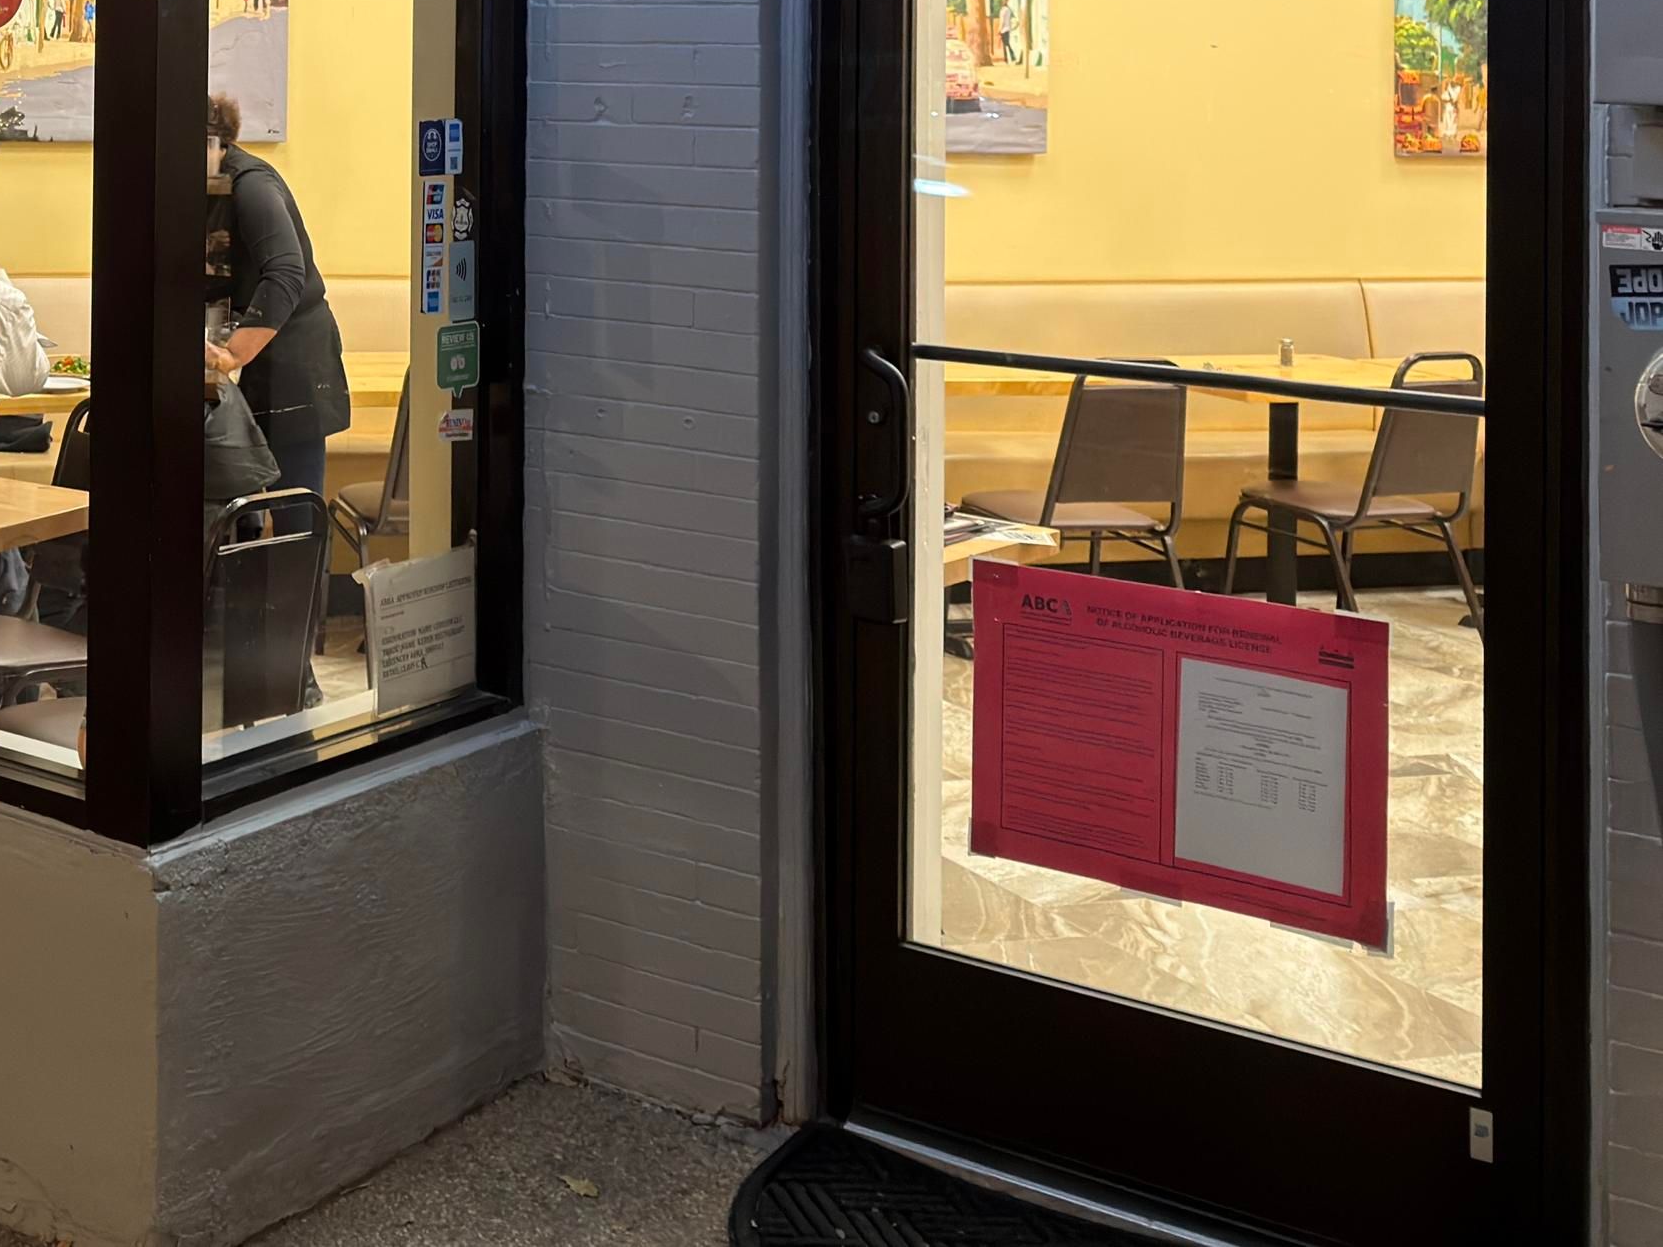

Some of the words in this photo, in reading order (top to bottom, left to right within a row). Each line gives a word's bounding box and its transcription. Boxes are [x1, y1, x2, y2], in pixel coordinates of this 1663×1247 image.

[427, 208, 444, 220] VISA
[441, 334, 464, 345] REVIEW
[1087, 605, 1122, 619] NOTICE
[1124, 611, 1139, 621] OF
[1141, 613, 1207, 633] APPLICATION
[1170, 630, 1228, 647] BEVERAGE
